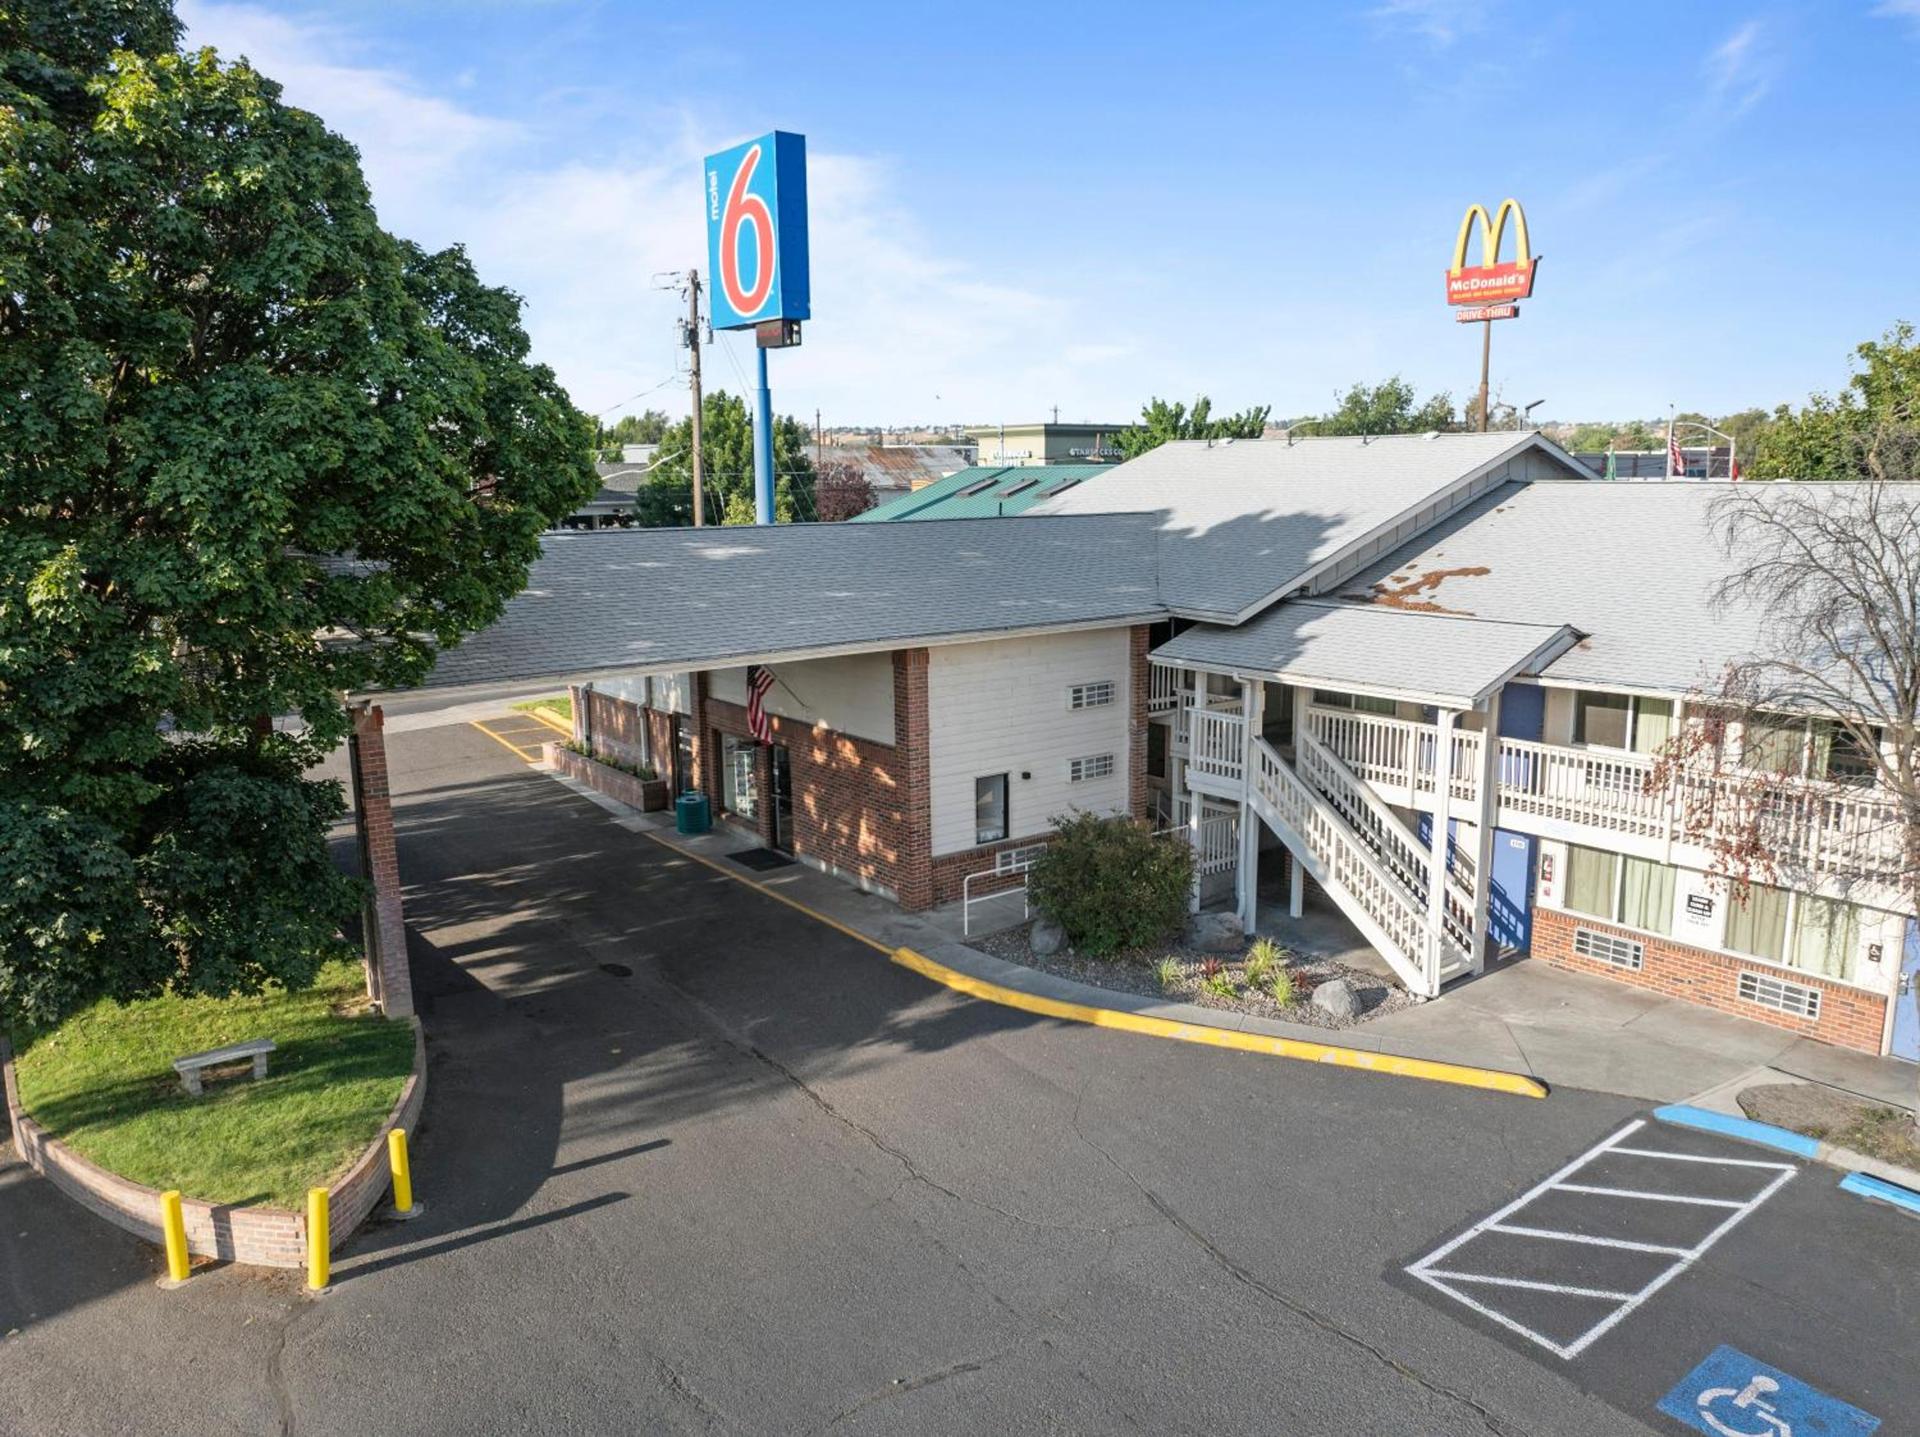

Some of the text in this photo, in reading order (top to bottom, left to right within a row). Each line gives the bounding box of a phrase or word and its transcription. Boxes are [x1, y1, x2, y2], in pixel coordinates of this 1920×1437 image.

[708, 171, 719, 221] motel
[719, 144, 775, 317] 6
[1450, 274, 1525, 291] McDonald's
